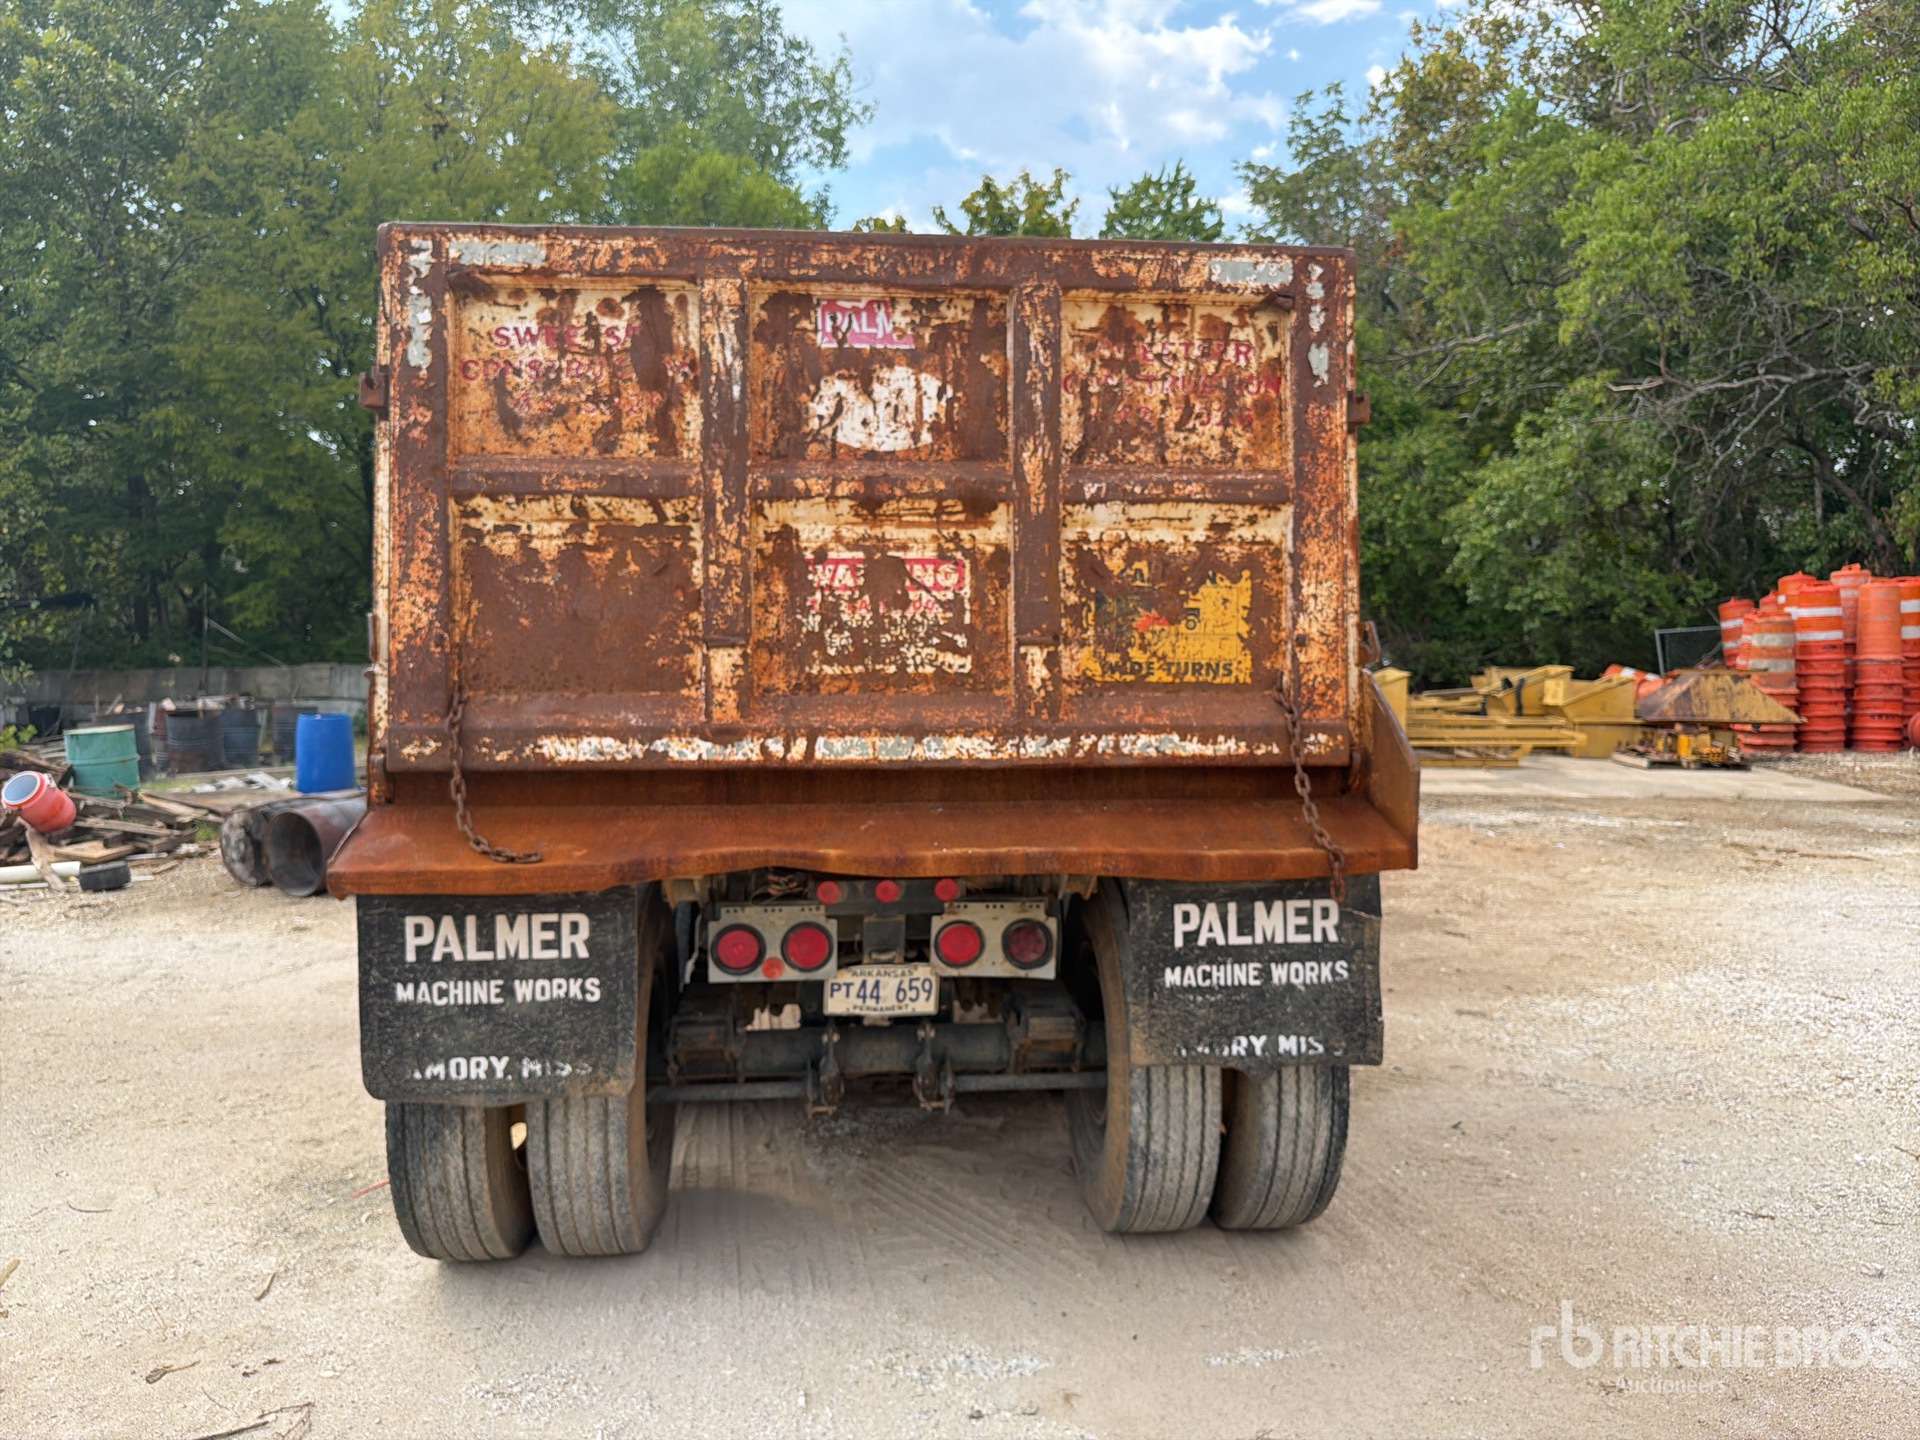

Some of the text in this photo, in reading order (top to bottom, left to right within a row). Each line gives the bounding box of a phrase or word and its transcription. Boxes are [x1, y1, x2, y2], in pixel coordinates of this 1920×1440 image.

[1166, 661, 1233, 678] TURNS
[404, 912, 591, 963] PALMER
[1173, 898, 1340, 949] PALMER
[851, 969, 914, 978] ARKANSAS
[1164, 960, 1350, 988] MACHINE WORKS
[396, 977, 602, 1006] MACHINE WORKS
[896, 977, 933, 1003] 659
